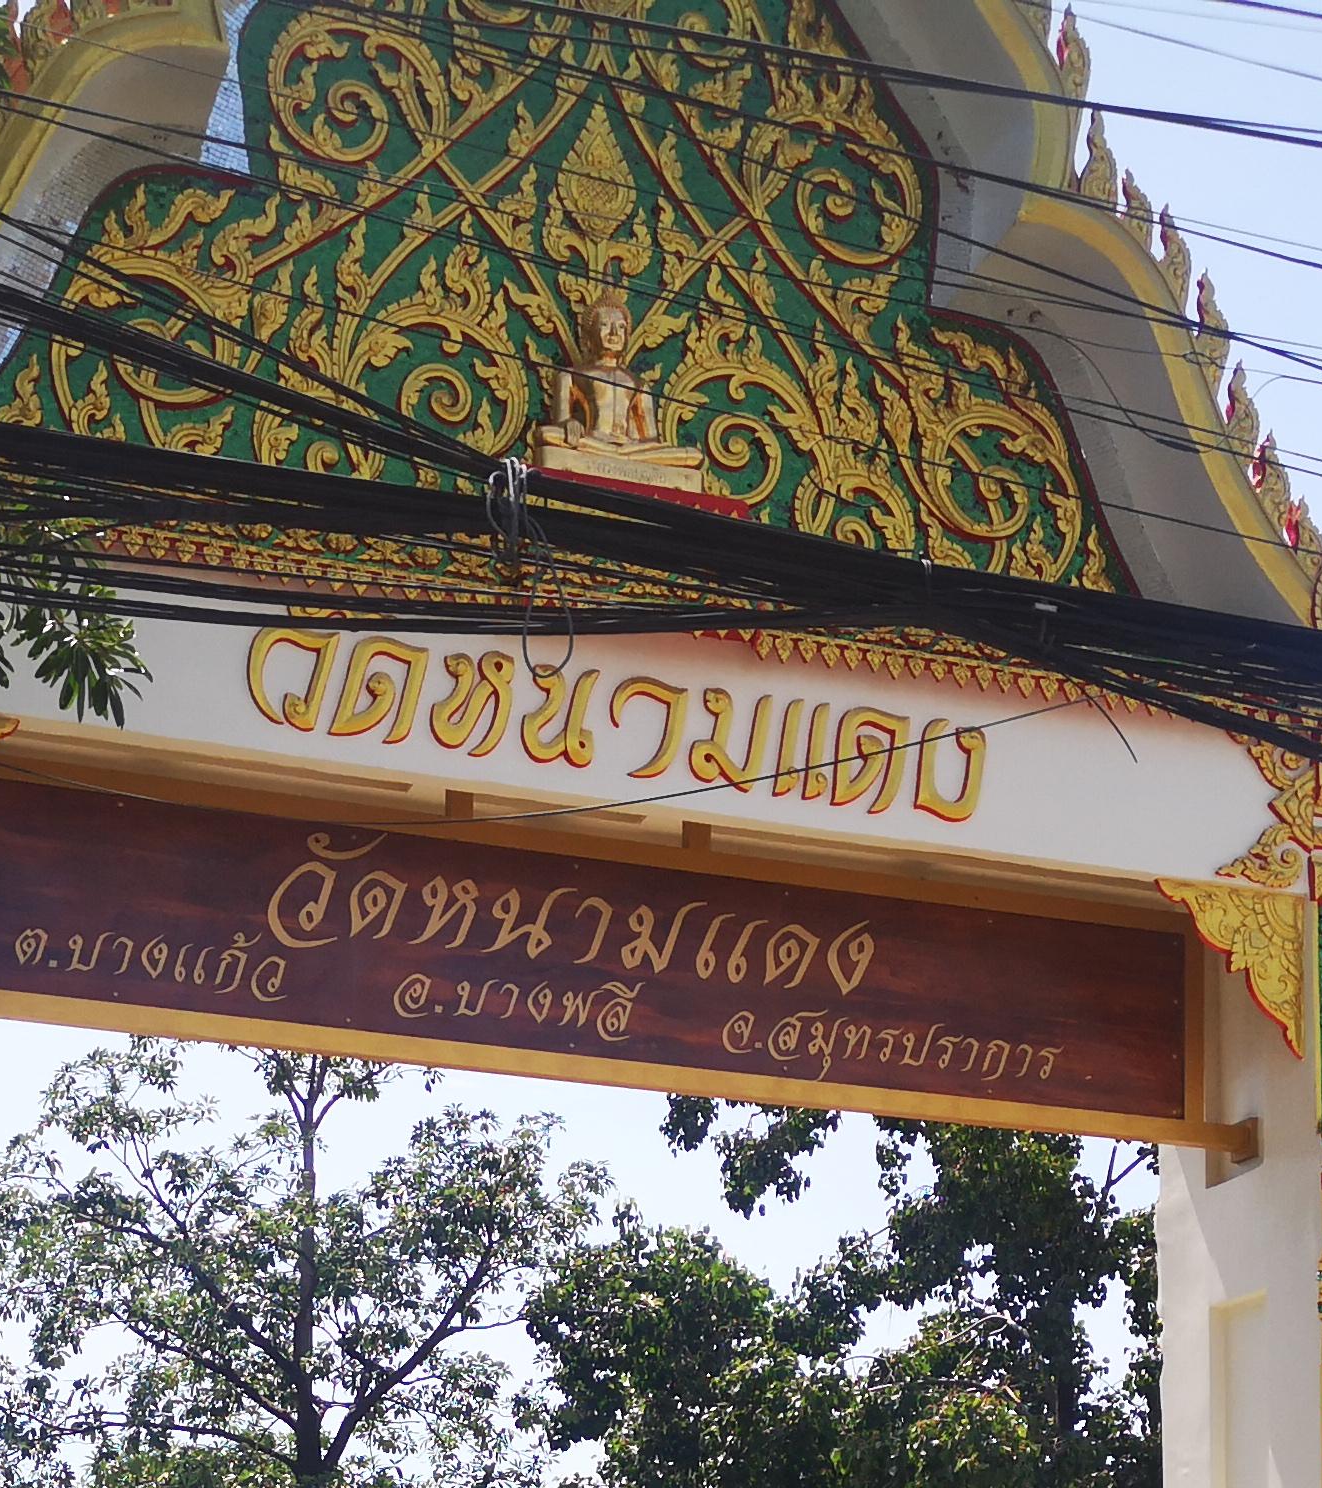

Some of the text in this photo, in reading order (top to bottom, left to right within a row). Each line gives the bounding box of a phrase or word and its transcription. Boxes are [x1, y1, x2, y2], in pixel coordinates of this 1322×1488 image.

[267, 832, 876, 996] วัดหนามแดง
[14, 928, 1065, 1082] ต.บางแก้ว อ.บางพลี จ.สมุทรปราการ
